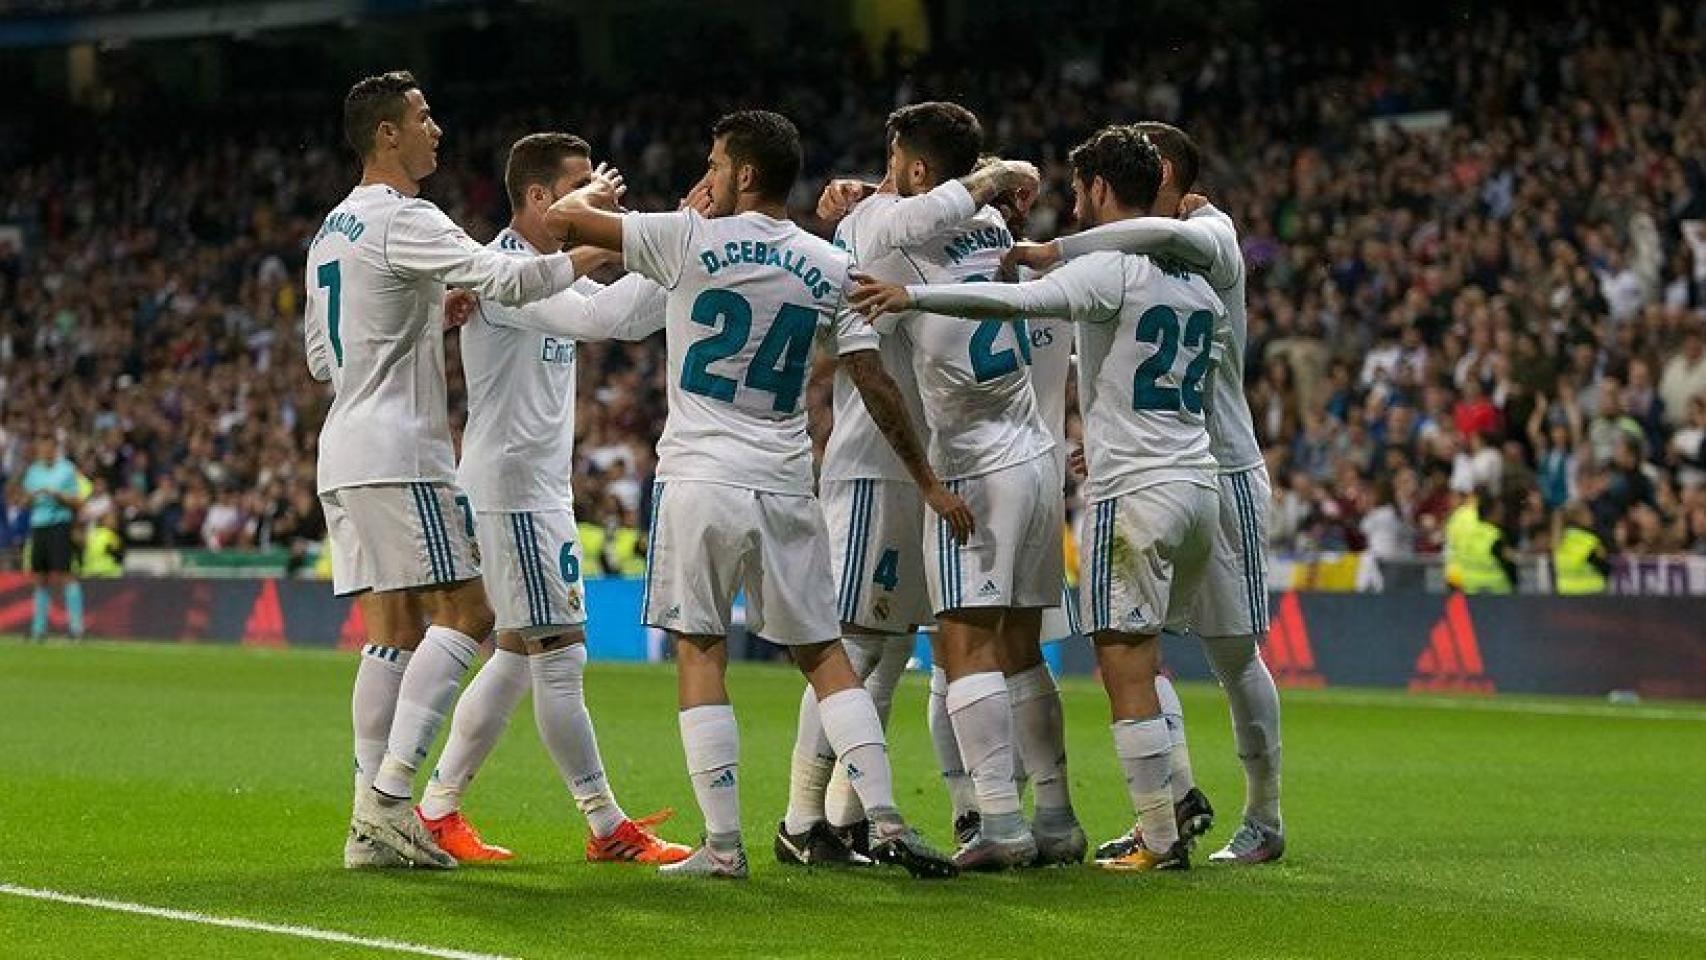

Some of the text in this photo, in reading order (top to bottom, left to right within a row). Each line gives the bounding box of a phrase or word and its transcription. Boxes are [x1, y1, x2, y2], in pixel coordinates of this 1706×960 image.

[700, 239, 832, 299] D.CEBALLOS
[316, 259, 343, 368] 7
[680, 287, 819, 414] 24
[1133, 304, 1214, 414] 22
[455, 496, 475, 537] 7
[560, 541, 579, 583] 6
[873, 549, 898, 591] 4
